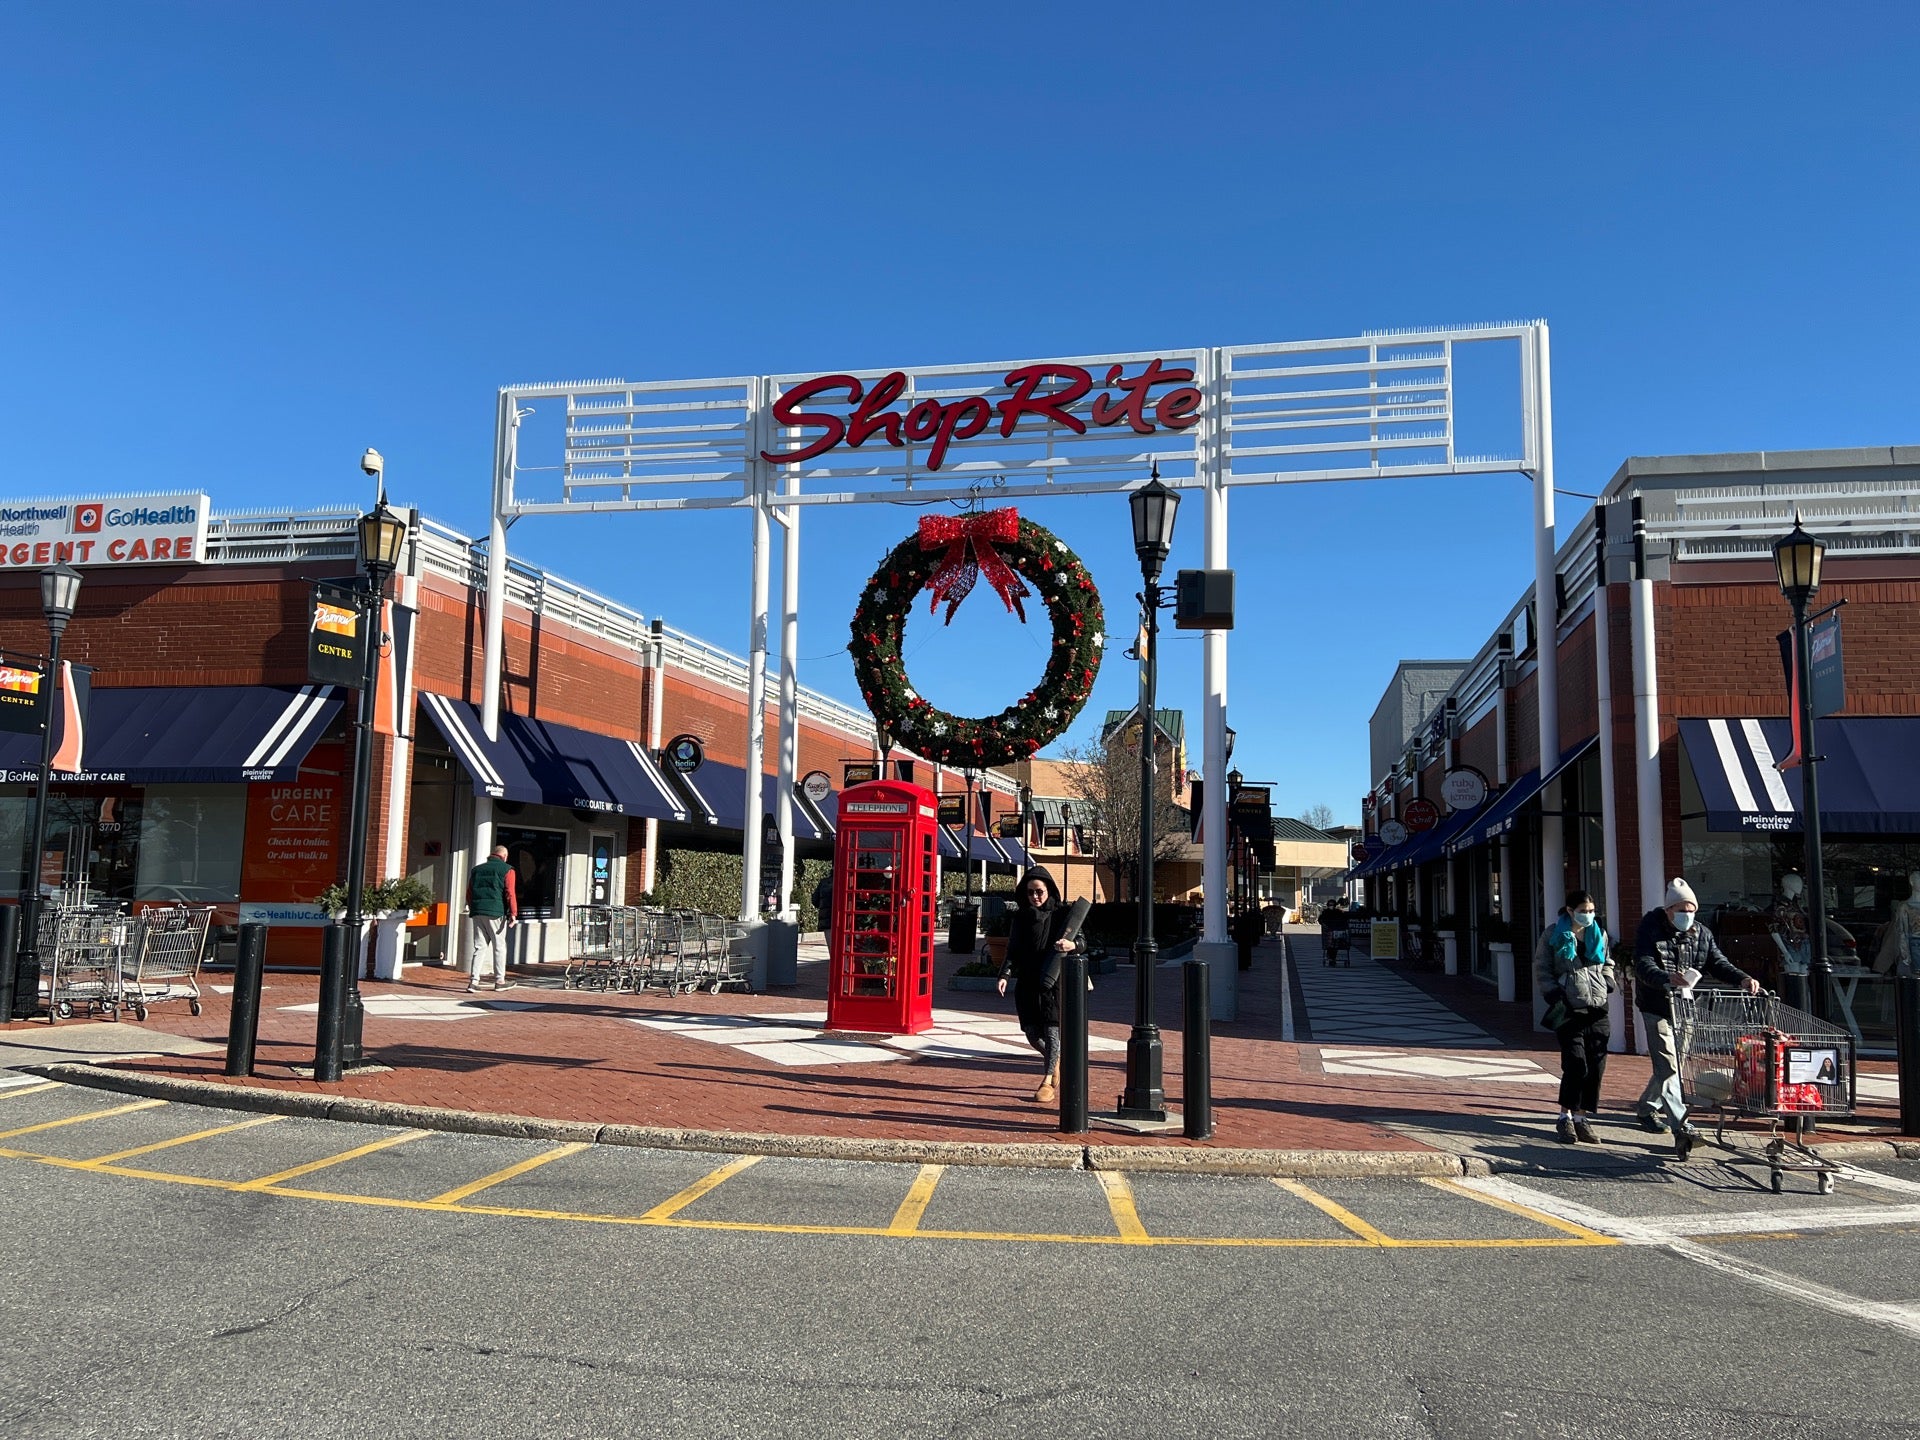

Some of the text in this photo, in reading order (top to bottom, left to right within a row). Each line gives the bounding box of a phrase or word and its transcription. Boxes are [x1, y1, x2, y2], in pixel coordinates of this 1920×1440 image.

[760, 358, 1202, 471] ShopRite
[1, 505, 67, 522] Northwell
[106, 505, 196, 527] GoHealth
[107, 536, 193, 561] CARE
[318, 643, 353, 659] CENTRE
[1, 695, 35, 706] CENTRE
[675, 760, 696, 768] tiedin
[61, 773, 98, 781] URGENT
[100, 773, 126, 781] CARE
[1451, 779, 1475, 789] ruby
[271, 788, 333, 800] URGENT
[574, 797, 605, 811] CHOCOLATE
[851, 804, 904, 812] TELEPHONE
[270, 805, 332, 822] CARE
[1742, 814, 1793, 826] plainview
[1755, 821, 1790, 830] centre
[98, 822, 121, 832] 377D
[268, 837, 330, 846] Check In Online
[267, 851, 328, 861] Or Just Walk In
